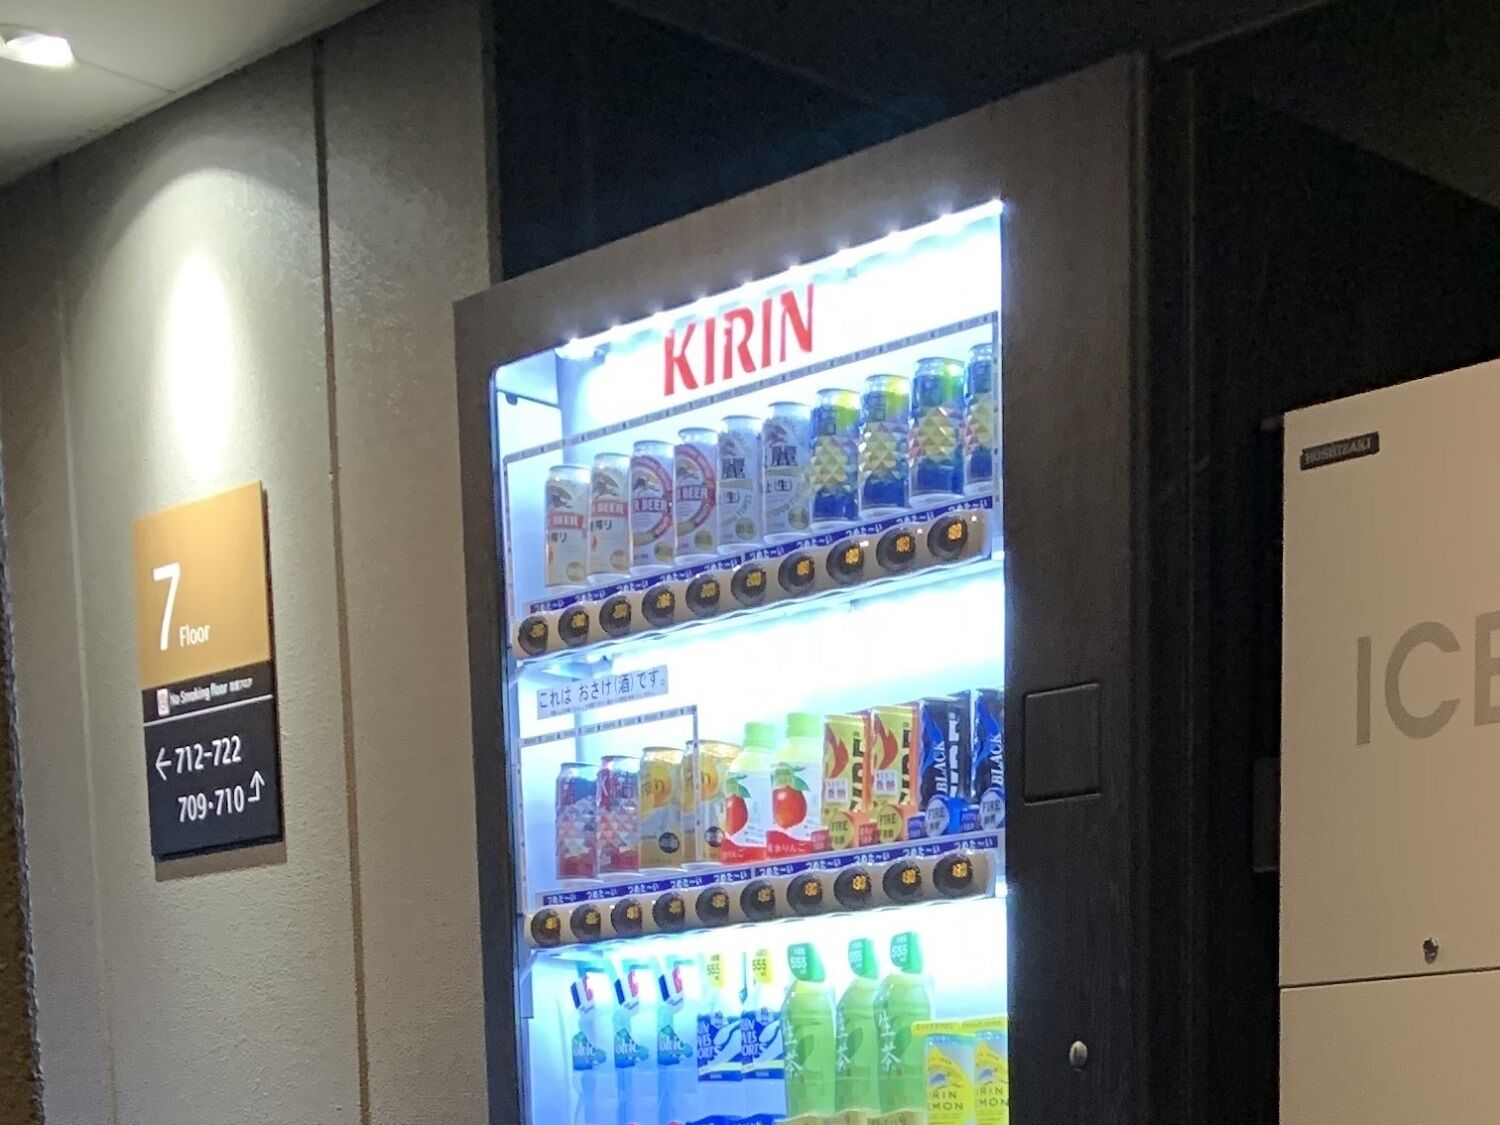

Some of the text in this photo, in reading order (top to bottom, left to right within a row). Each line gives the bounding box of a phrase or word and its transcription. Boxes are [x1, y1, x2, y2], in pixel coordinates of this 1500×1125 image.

[663, 283, 815, 396] KIRIN
[153, 562, 180, 651] 7
[179, 624, 211, 648] Floor
[539, 688, 571, 708] これは
[175, 735, 242, 774] 712-722
[933, 740, 949, 796] BLACK
[991, 732, 1005, 787] BLACK
